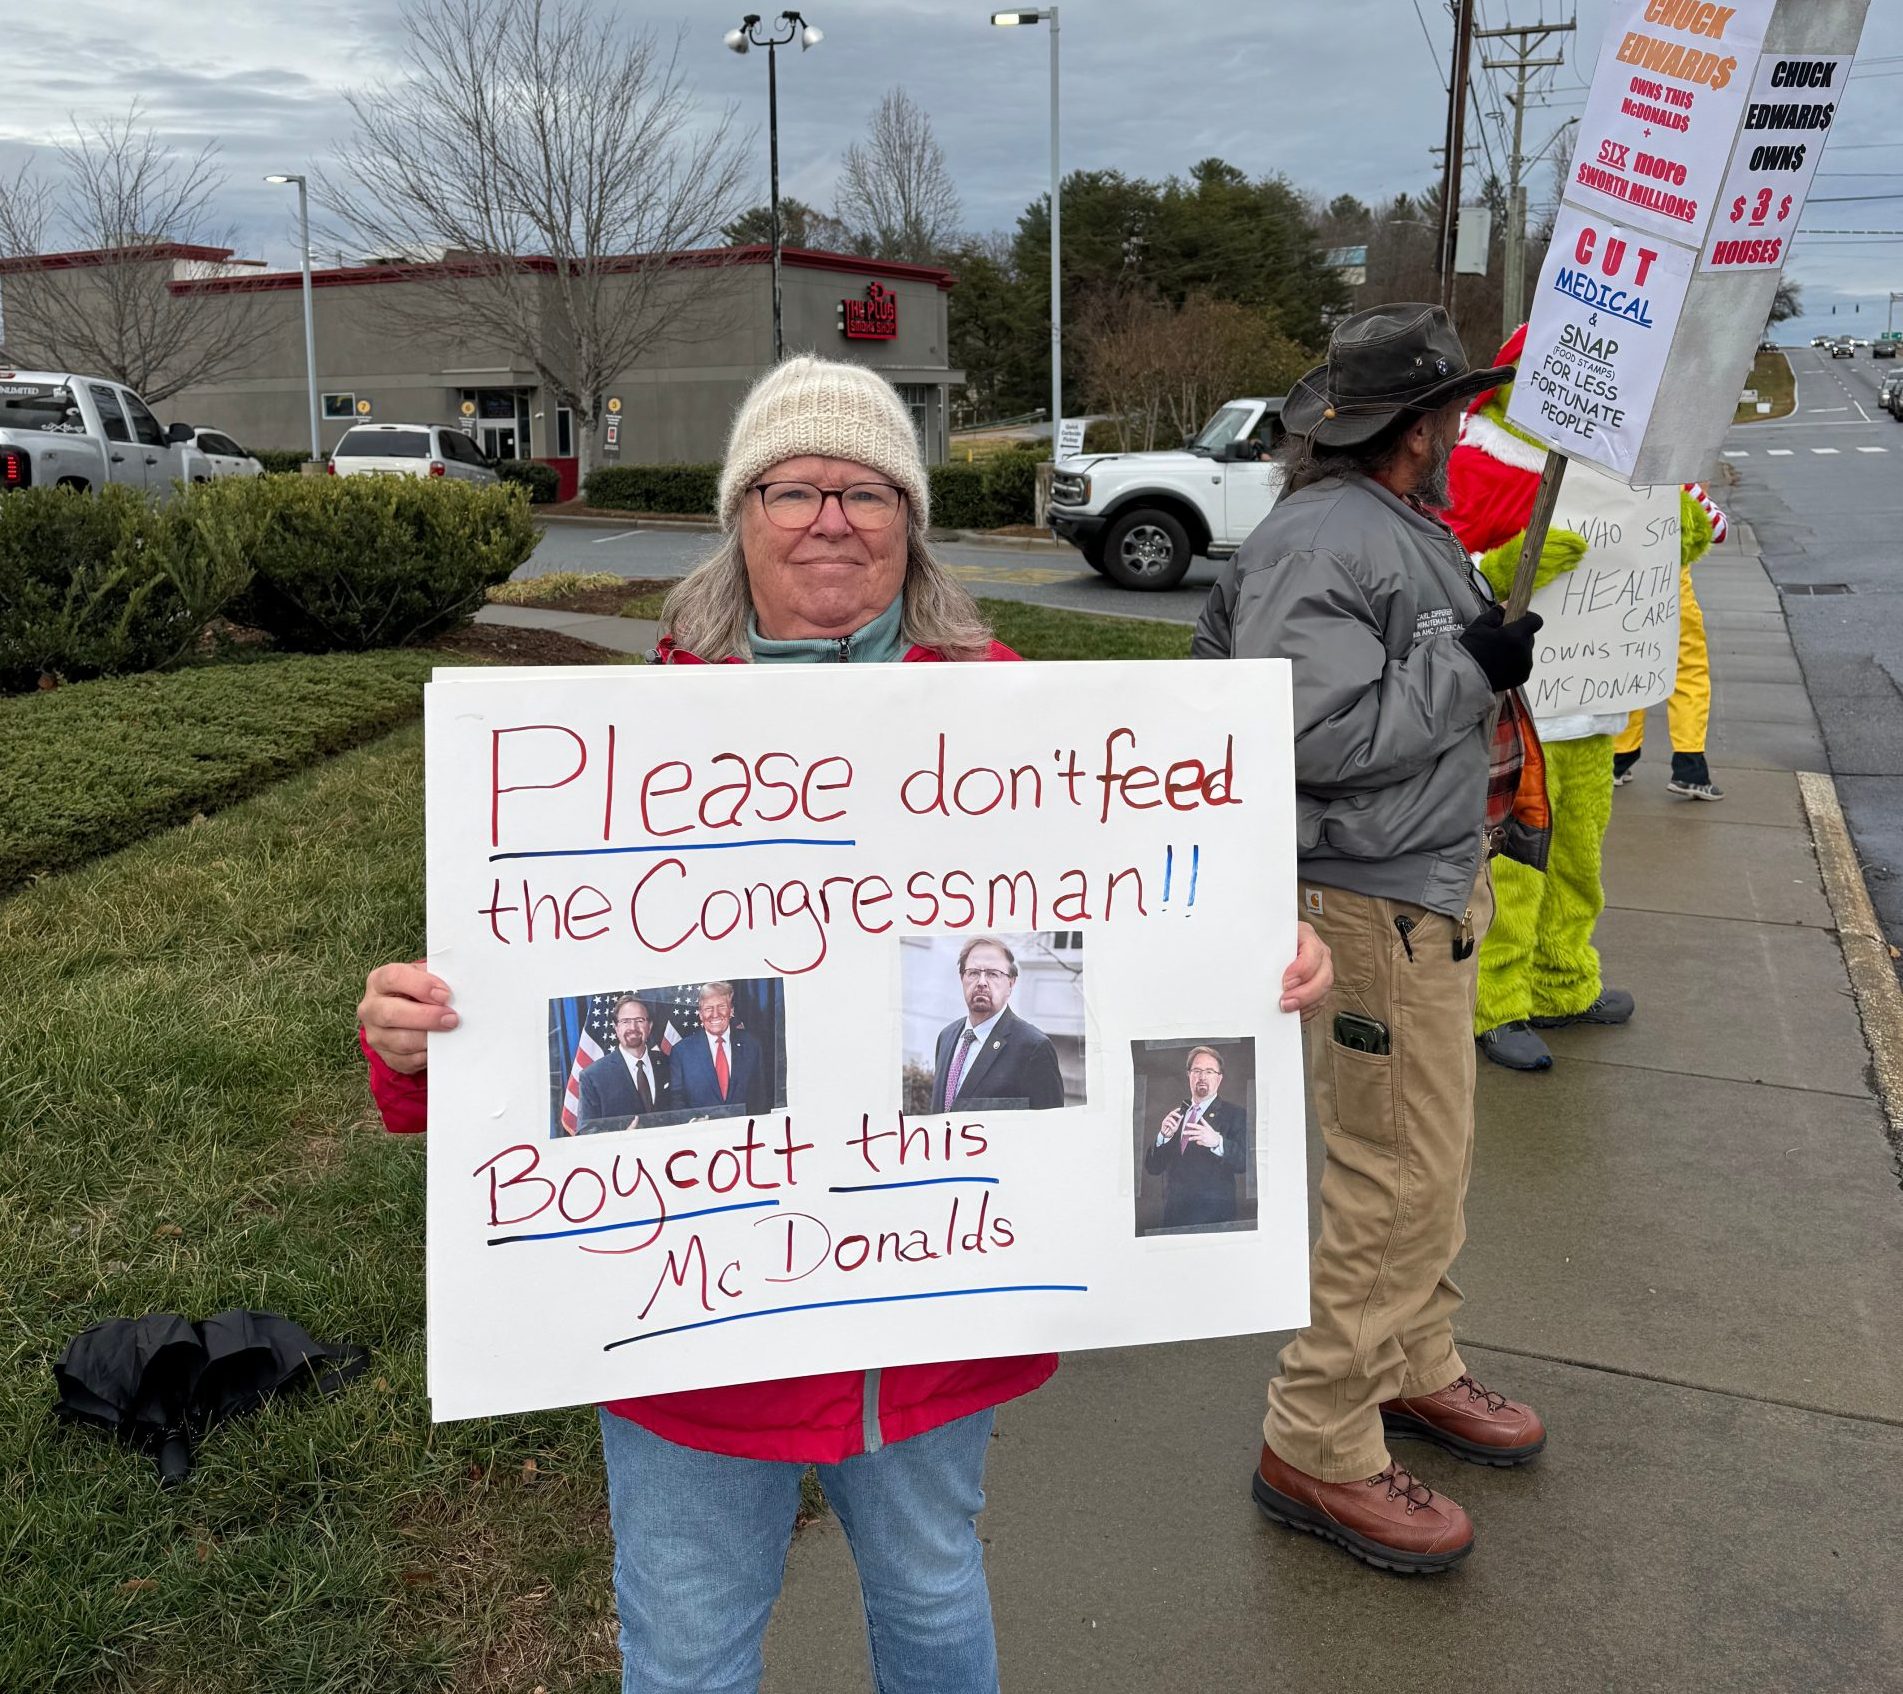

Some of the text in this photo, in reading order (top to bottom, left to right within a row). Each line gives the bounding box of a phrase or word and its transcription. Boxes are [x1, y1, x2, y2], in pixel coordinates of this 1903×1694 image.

[1643, 0, 1736, 40] CHUCK
[1616, 32, 1738, 91] EDWARD$
[1771, 61, 1838, 88] CHUCK
[1629, 76, 1694, 110] OWN$ THI$
[1621, 97, 1691, 133] McDONALD$
[1744, 103, 1835, 131] EDWARD$
[1599, 139, 1687, 187] SIX more
[1749, 144, 1806, 172] OWN$
[1577, 162, 1697, 222] $WORTH MILLION$
[1751, 188, 1773, 221] 3
[1711, 237, 1782, 265] HOUSE$
[1555, 267, 1653, 324] MEDICAL
[1588, 312, 1598, 327] &
[1560, 323, 1619, 361] SNAP
[1543, 355, 1618, 401] FOR LESS
[1553, 345, 1616, 381] (FOOD STAMPS)
[0, 386, 39, 395] NLIMITED
[1530, 370, 1625, 428] FORTUNATE
[1541, 401, 1597, 440] PEOPLE
[1566, 516, 1622, 549] WHO
[1561, 562, 1673, 616] HEALTH
[1622, 596, 1676, 632] CARE
[1540, 641, 1662, 664] OWNS THIS
[491, 724, 1243, 848] Please don't feed
[478, 845, 1200, 975] the Congressman!!
[473, 1112, 990, 1255] Boycott this
